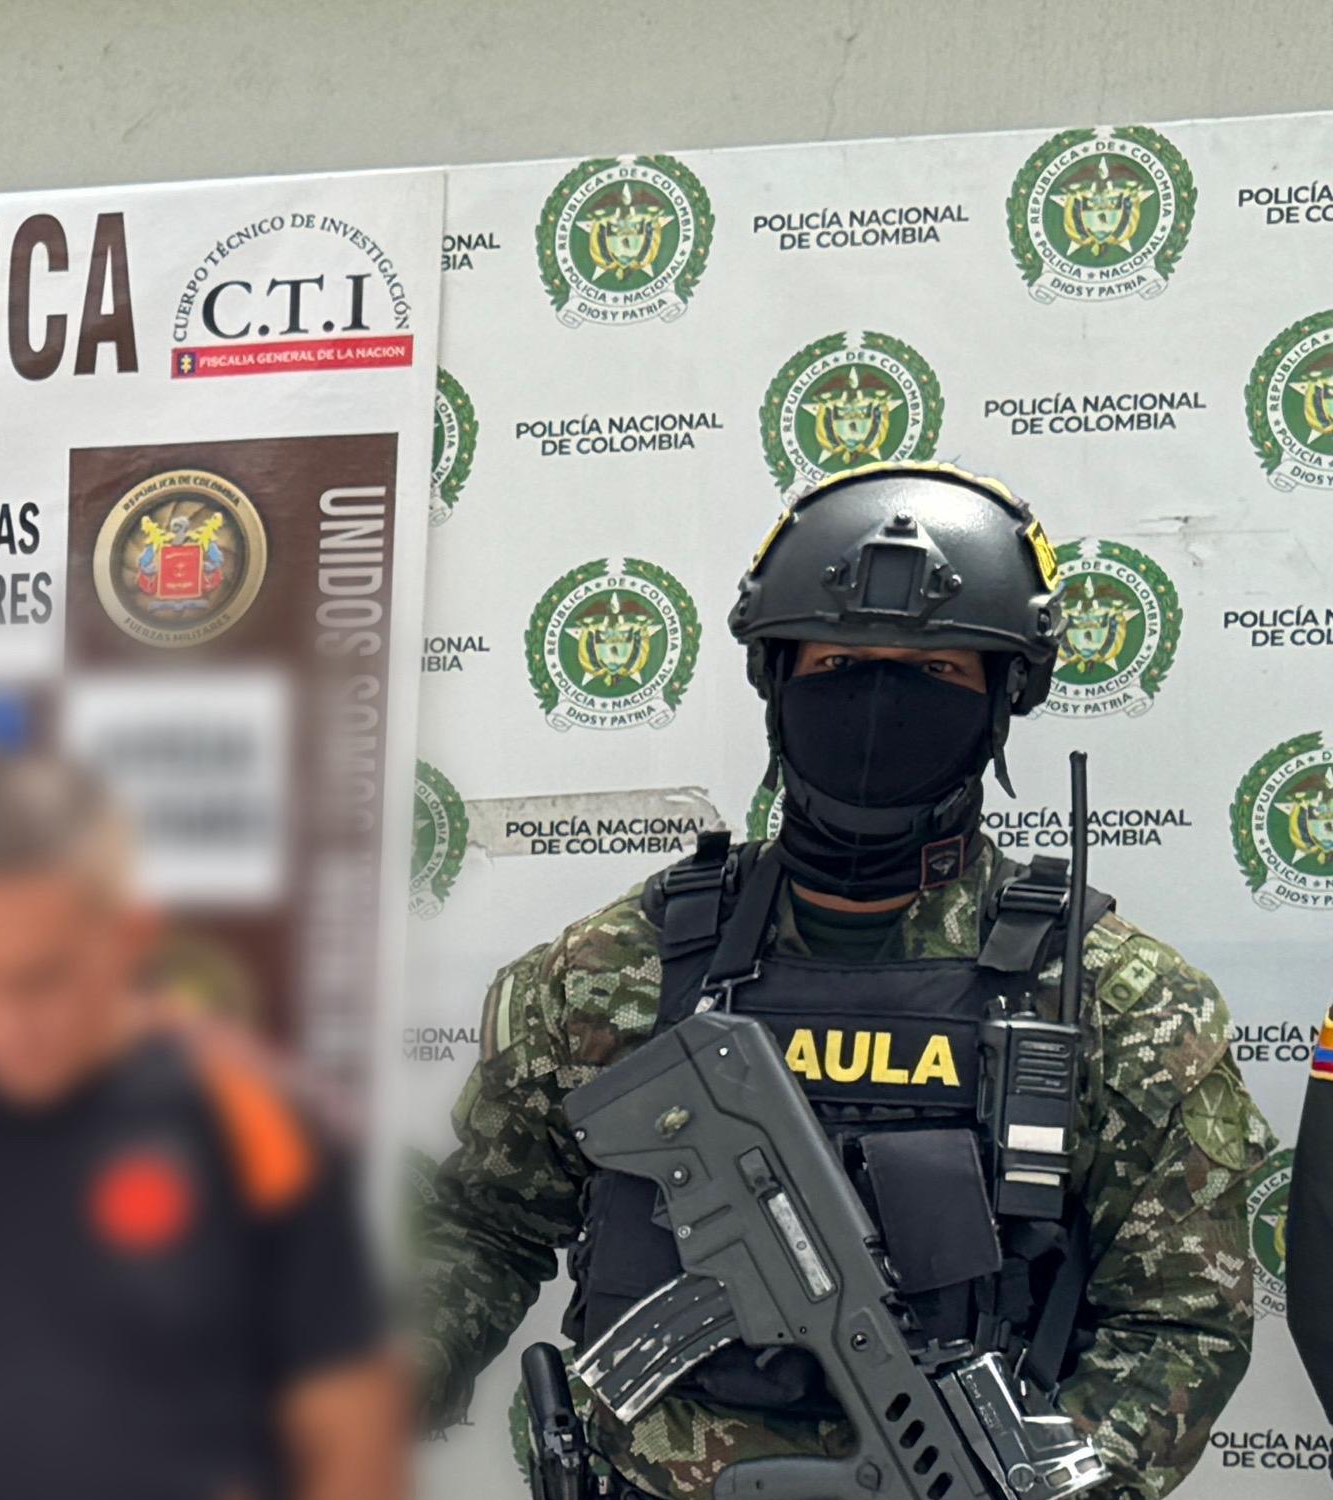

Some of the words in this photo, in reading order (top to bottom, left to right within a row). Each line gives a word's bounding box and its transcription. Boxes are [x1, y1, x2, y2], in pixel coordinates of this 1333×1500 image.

[1095, 141, 1115, 151] DE
[1131, 147, 1173, 218] COLOMBIA
[619, 168, 638, 178] DE
[651, 173, 692, 243] COLOMBIA
[1238, 181, 1333, 207] POLICÍA
[753, 208, 840, 232] POLICÍA
[850, 204, 969, 231] NACIONAL
[1266, 206, 1299, 225] DE
[442, 233, 501, 252] ONAL
[780, 231, 811, 250] DE
[815, 226, 940, 250] COLOMBIA
[1099, 235, 1165, 279] NACIONAL
[173, 266, 208, 342] CUERPO
[204, 216, 284, 267] TÉCNICO
[290, 213, 316, 229] DE
[320, 216, 412, 330] INVESTIGACIÓN
[623, 259, 684, 304] NACIONAL
[1099, 274, 1147, 297] PATRIA
[202, 273, 372, 340] C.T.I
[622, 299, 667, 321] PATRIA
[256, 350, 314, 365] GENERAL
[316, 348, 334, 361] DE
[337, 348, 354, 360] LA
[845, 351, 865, 361] DE
[880, 358, 921, 427] COLOMBIA
[984, 393, 1077, 417] POLICÍA
[1082, 391, 1206, 412] NACIONAL
[438, 403, 456, 449] OMBIA
[516, 414, 600, 439] POLICÍA
[609, 412, 724, 435] NACIONAL
[1011, 417, 1043, 436] DE
[1049, 413, 1176, 434] COLOMBIA
[541, 438, 571, 456] DE
[576, 432, 695, 456] COLOMBIA
[790, 449, 825, 481] POLIC
[316, 486, 386, 656] UNIDOS
[1081, 561, 1101, 570] DE
[1116, 567, 1158, 638] COLOMBIA
[607, 578, 626, 588] DE
[640, 584, 679, 650] COLOMBIA
[1224, 605, 1316, 629] POLICÍA
[424, 636, 491, 653] IONAL
[1252, 629, 1284, 647] DE
[1085, 653, 1150, 697] NACIONAL
[612, 667, 673, 709] NACIONAL
[1084, 692, 1133, 713] PATRIA
[610, 705, 656, 726] PATRIA
[417, 785, 447, 845] OLOMBIA
[506, 816, 588, 838] POLICÍA
[531, 839, 561, 855] DE
[566, 837, 683, 855] COLOMBIA
[997, 832, 1029, 848] DE
[412, 861, 441, 889] ONAL
[403, 1027, 480, 1044] CIONAL
[1234, 1021, 1306, 1043] OLICÍA
[785, 1028, 961, 1087] AULA
[1237, 1044, 1269, 1062] DE
[1261, 1295, 1285, 1312] DIO
[1210, 1429, 1288, 1450] OLICÍA
[1223, 1451, 1256, 1468] DE
[1260, 1452, 1327, 1470] COLO
